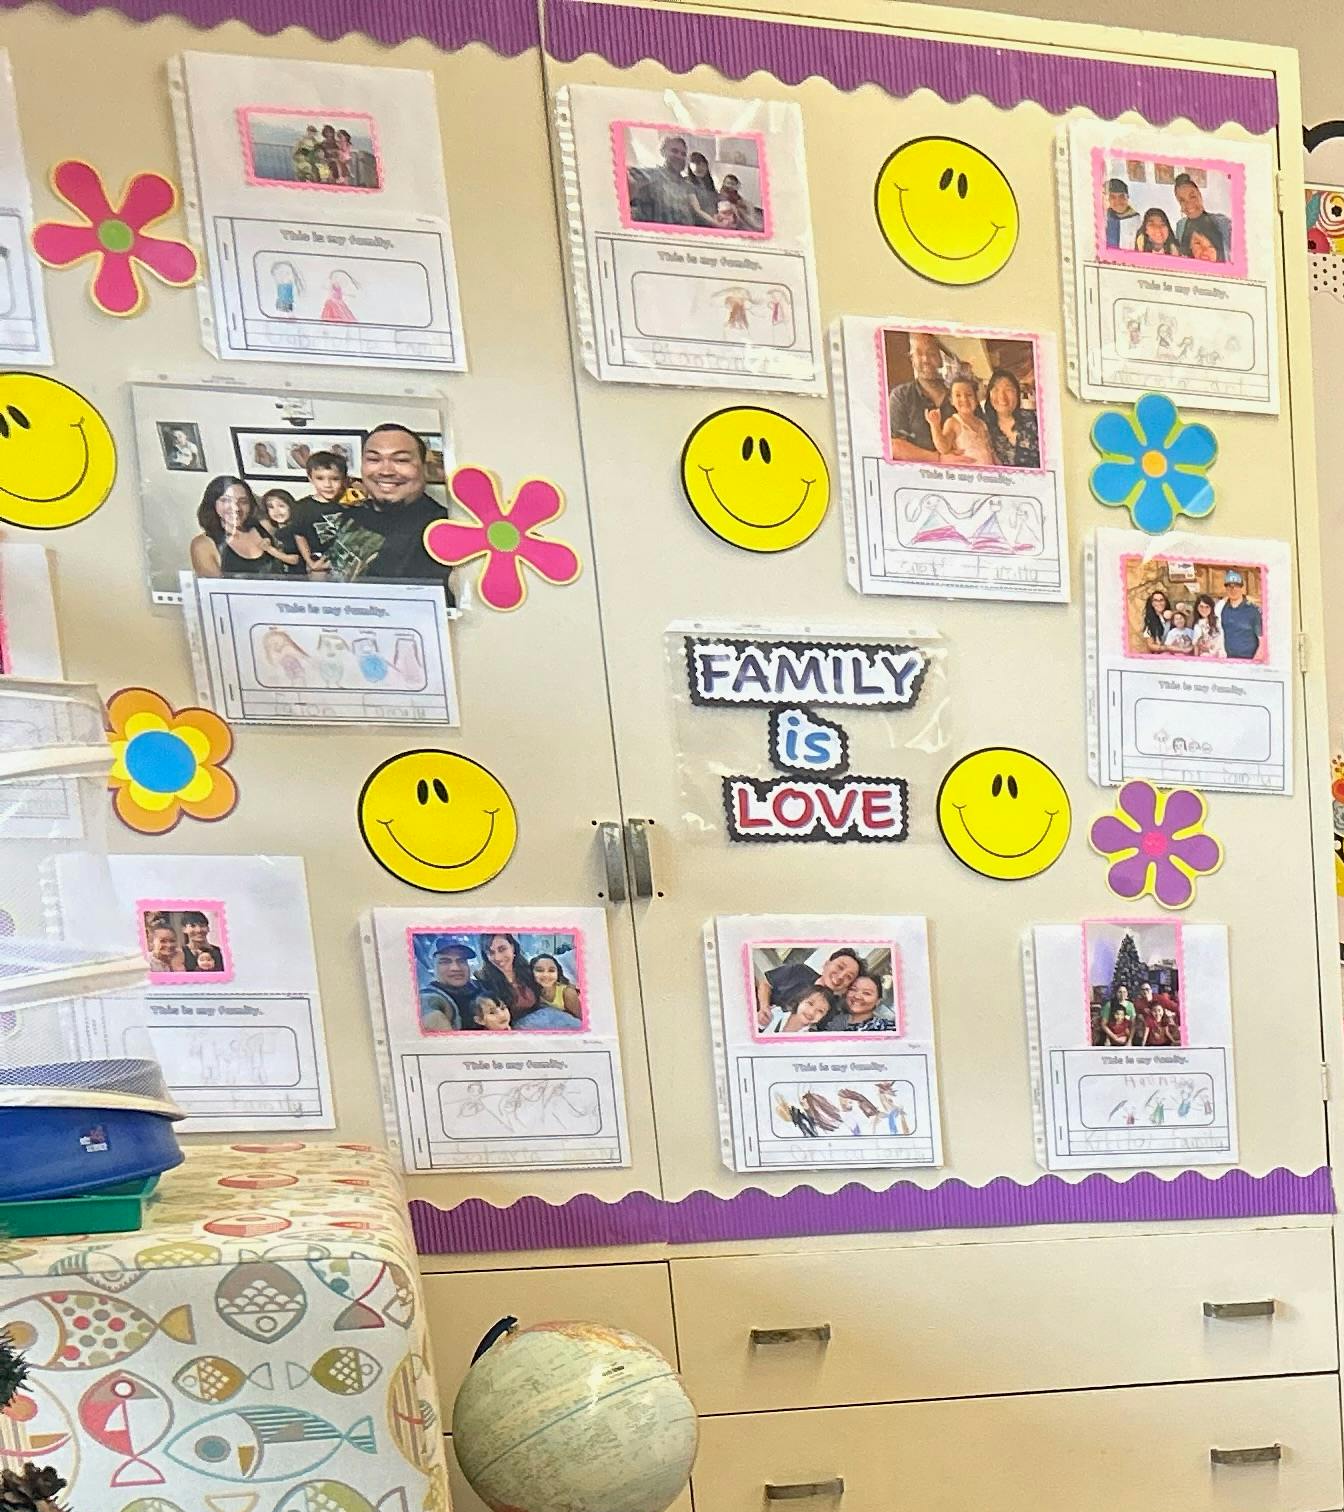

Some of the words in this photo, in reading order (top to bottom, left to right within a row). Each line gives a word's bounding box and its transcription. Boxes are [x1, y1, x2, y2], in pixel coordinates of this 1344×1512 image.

[697, 652, 919, 697] FAMILY
[785, 715, 832, 765] is
[737, 787, 896, 830] LOVE
[150, 1005, 179, 1017] This
[180, 1005, 194, 1017] is
[196, 1008, 215, 1019] my
[218, 1005, 264, 1019] family.
[463, 1061, 490, 1071] This
[492, 1059, 503, 1071] is
[505, 1060, 524, 1072] my
[526, 1058, 568, 1071] family.
